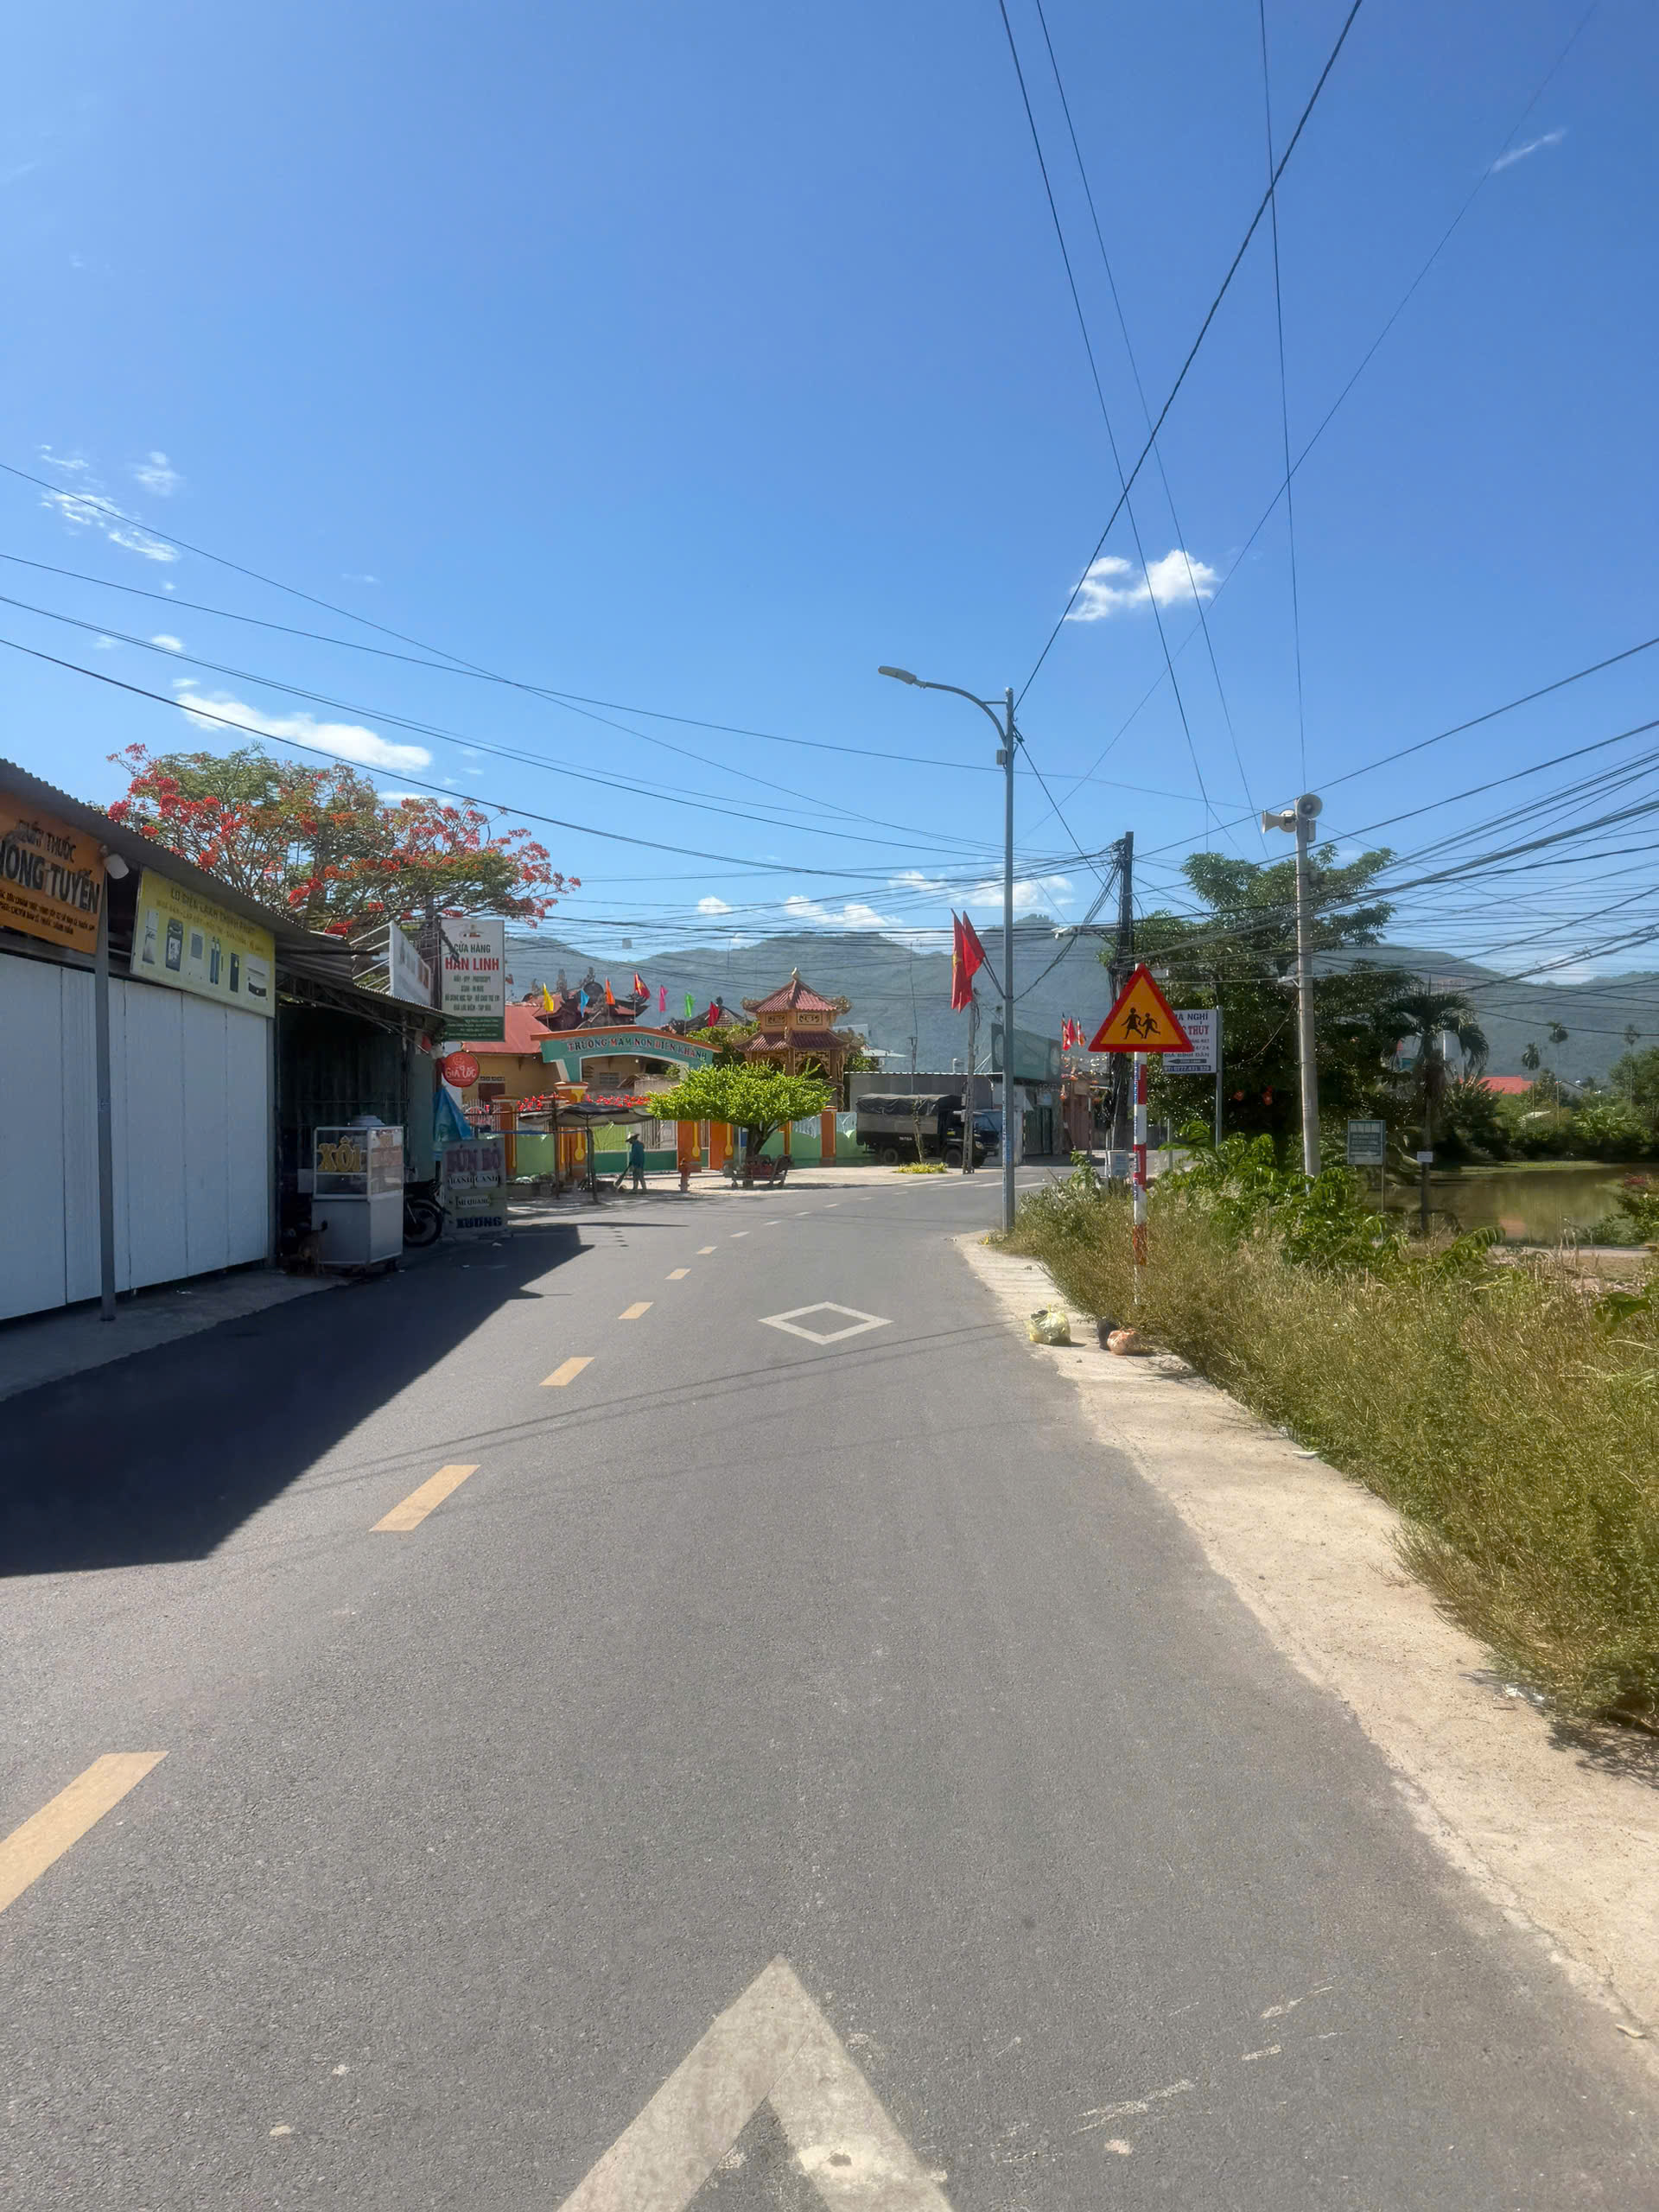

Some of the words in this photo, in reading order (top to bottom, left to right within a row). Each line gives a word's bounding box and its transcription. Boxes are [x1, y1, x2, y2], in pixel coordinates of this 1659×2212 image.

[473, 957, 499, 970] LINH
[634, 1038, 652, 1048] NON
[318, 1135, 360, 1172] XÔI
